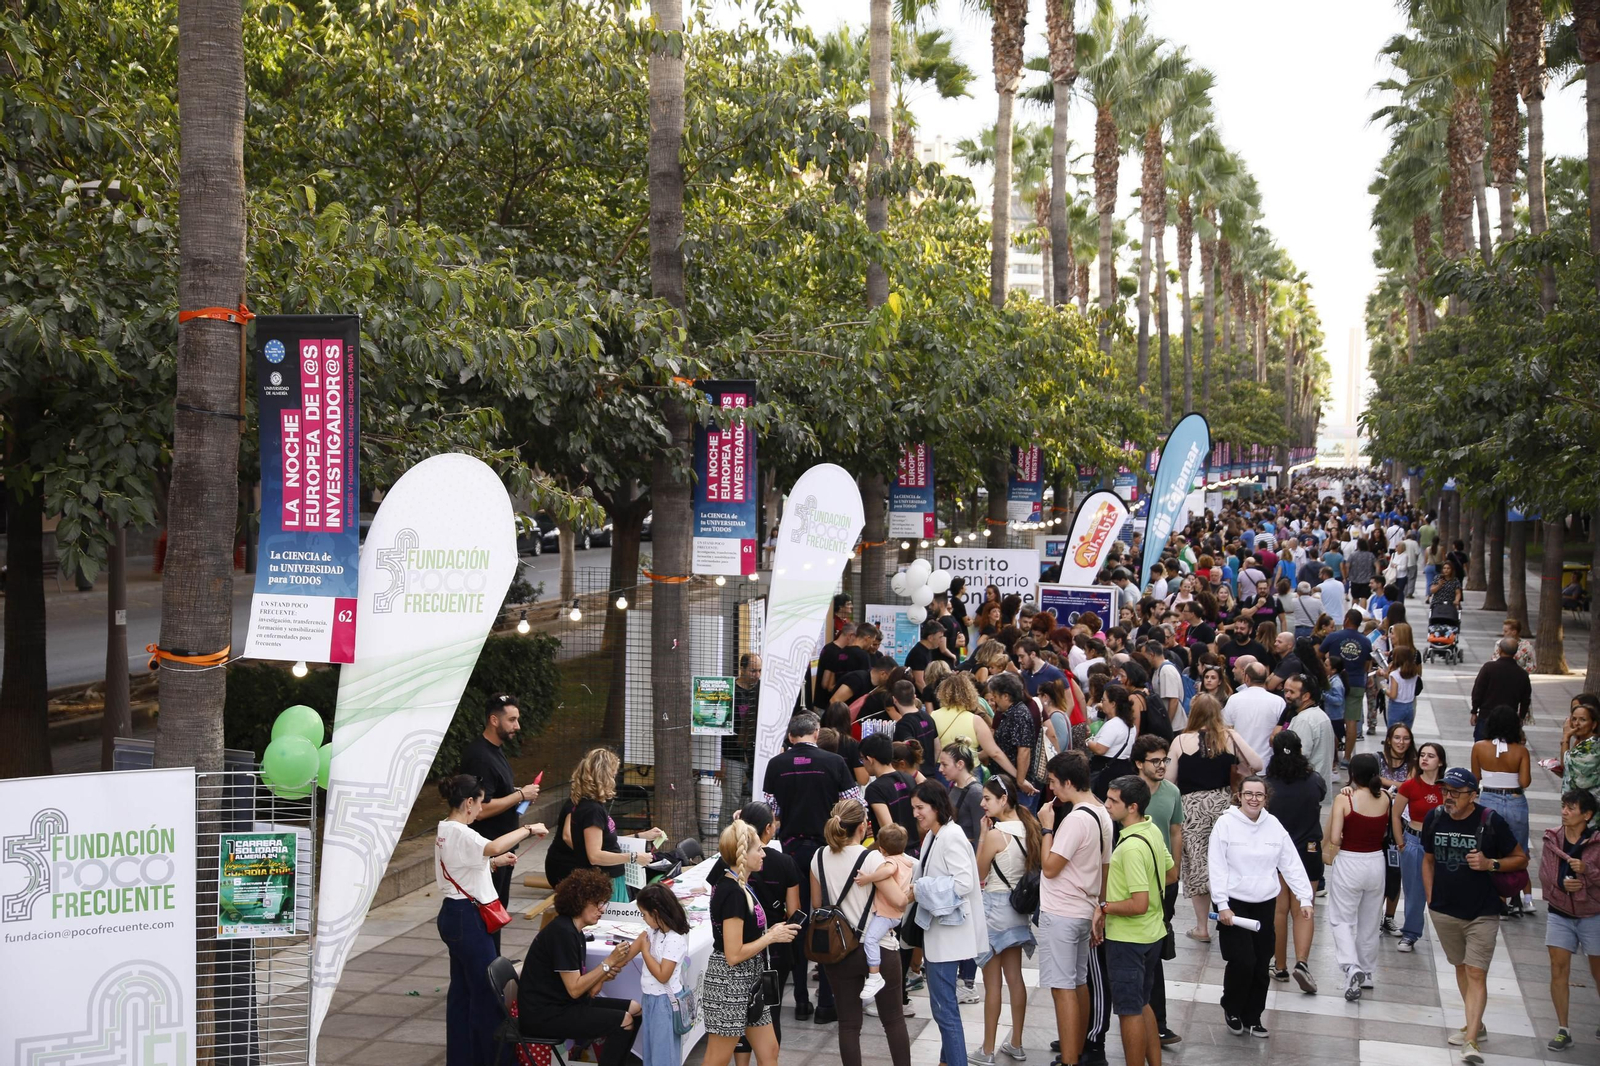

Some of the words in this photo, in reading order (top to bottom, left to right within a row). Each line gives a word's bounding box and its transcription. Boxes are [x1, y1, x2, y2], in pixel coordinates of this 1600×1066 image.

[303, 345, 319, 388] L@S
[305, 394, 320, 421] DE
[325, 344, 341, 528] INVESTIGADOR@S
[284, 415, 300, 488] NOCHE
[709, 435, 719, 477] NOCHE
[305, 430, 320, 527] EUROPEA
[721, 444, 731, 500] EUROPEA
[899, 473, 907, 486] LA
[1167, 441, 1199, 512] cajamar
[708, 483, 718, 499] LA
[285, 499, 299, 527] LA
[810, 508, 852, 529] FUNDACIÓN
[808, 521, 849, 542] POCO
[1083, 510, 1118, 563] Alhabia
[743, 545, 752, 553] 61
[806, 534, 848, 554] FRECUENTE
[270, 551, 281, 560] La
[282, 551, 321, 561] CIENCIA
[321, 552, 332, 562] de
[407, 546, 490, 570] FUNDACIÓN
[939, 555, 1008, 571] Distrito
[268, 576, 288, 585] para
[289, 575, 322, 585] TODOS
[269, 564, 279, 572] tu
[280, 564, 344, 575] UNIVERSIDAD
[406, 569, 487, 593] POCO
[260, 608, 297, 616] FRECUENTE:
[404, 593, 485, 613] FRECUENTE
[258, 616, 292, 624] investigación,
[338, 609, 353, 622] 62
[52, 824, 175, 862] FUNDACIÓN
[235, 839, 283, 847] CARRERA
[235, 846, 288, 854] SOLIDARIA
[1434, 835, 1448, 846] DE
[1450, 837, 1477, 849] BAR
[52, 854, 175, 893] POCO
[52, 884, 175, 919] FRECUENTE
[5, 920, 174, 943] fundacion@pocofrecuente.com
